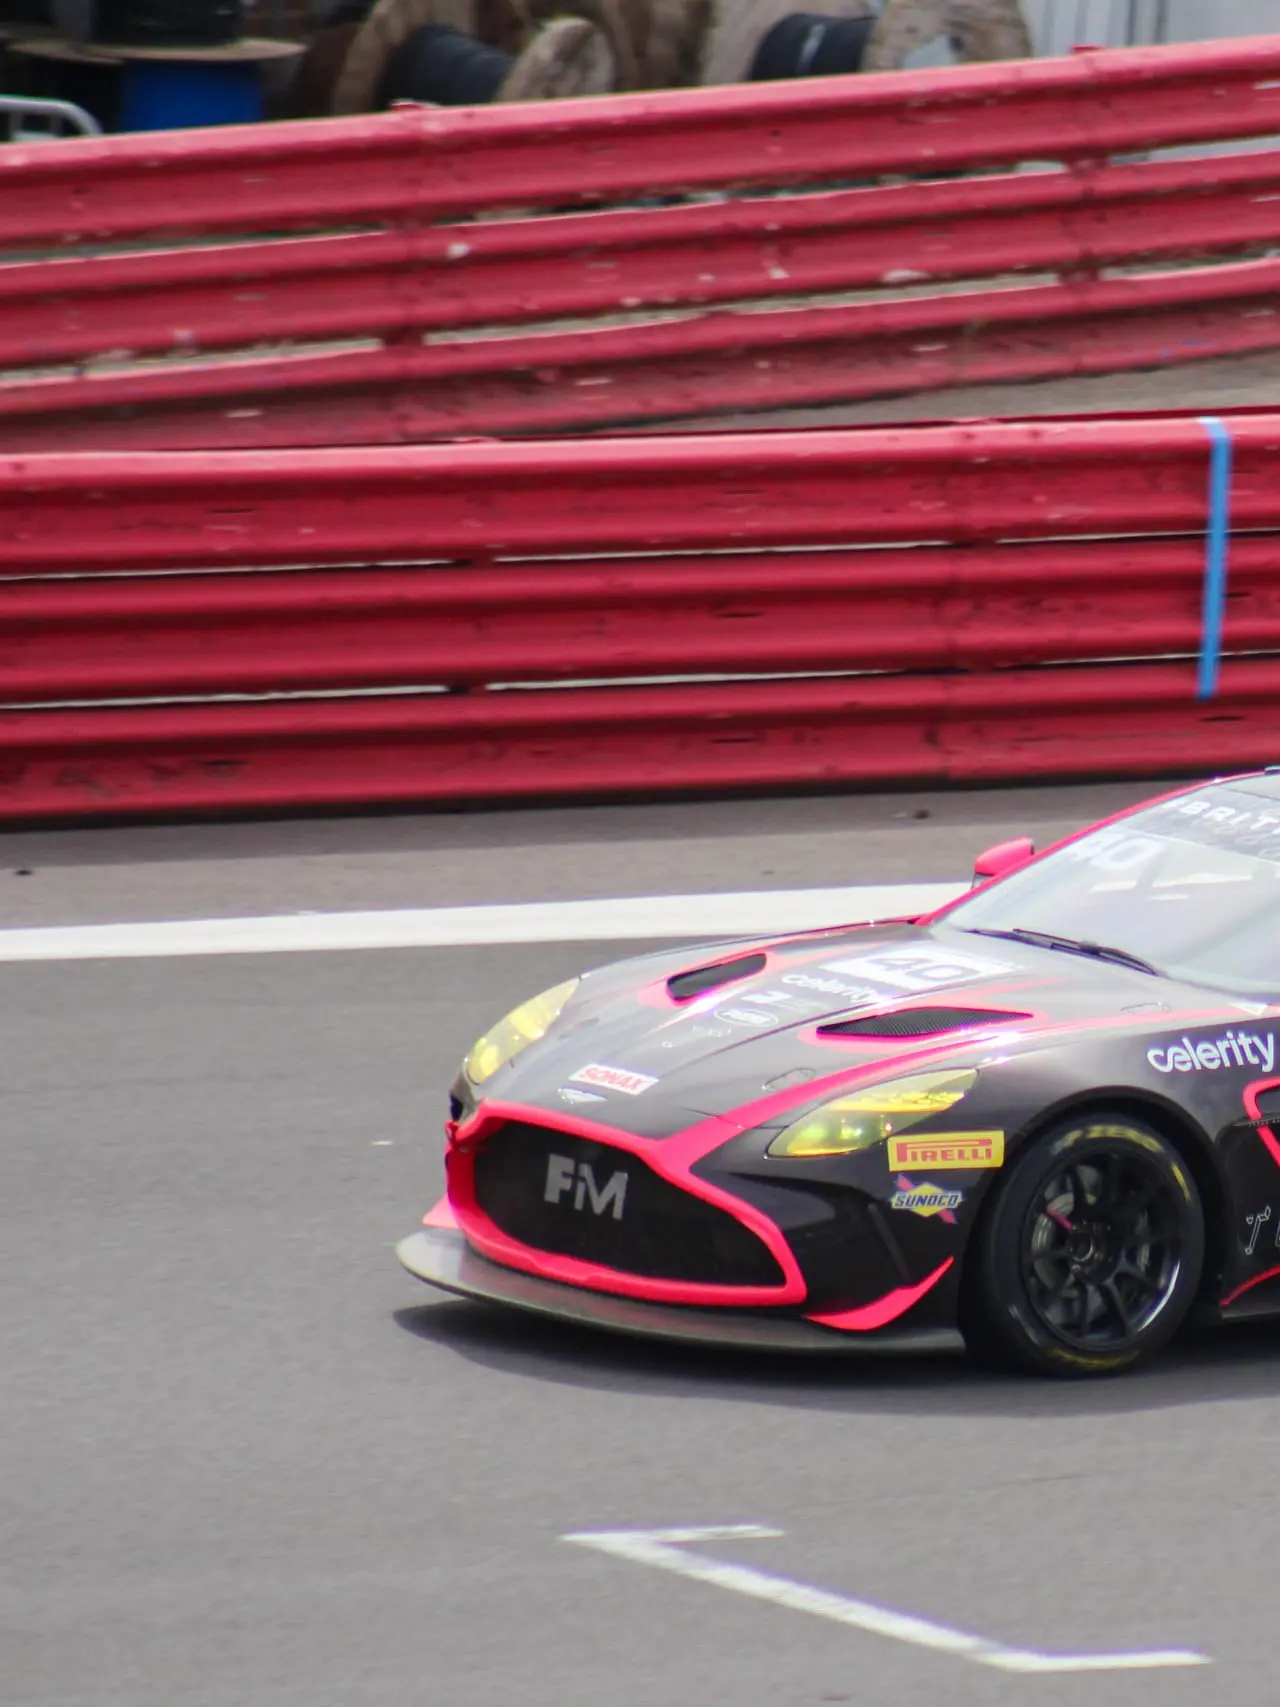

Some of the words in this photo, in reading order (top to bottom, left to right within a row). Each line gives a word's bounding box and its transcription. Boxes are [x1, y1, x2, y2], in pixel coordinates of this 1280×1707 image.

[864, 957, 982, 981] 40
[1147, 1030, 1274, 1073] celerity
[579, 1066, 648, 1091] SONAX
[896, 1138, 993, 1163] PIRELLI
[895, 1193, 960, 1208] SUNOCO
